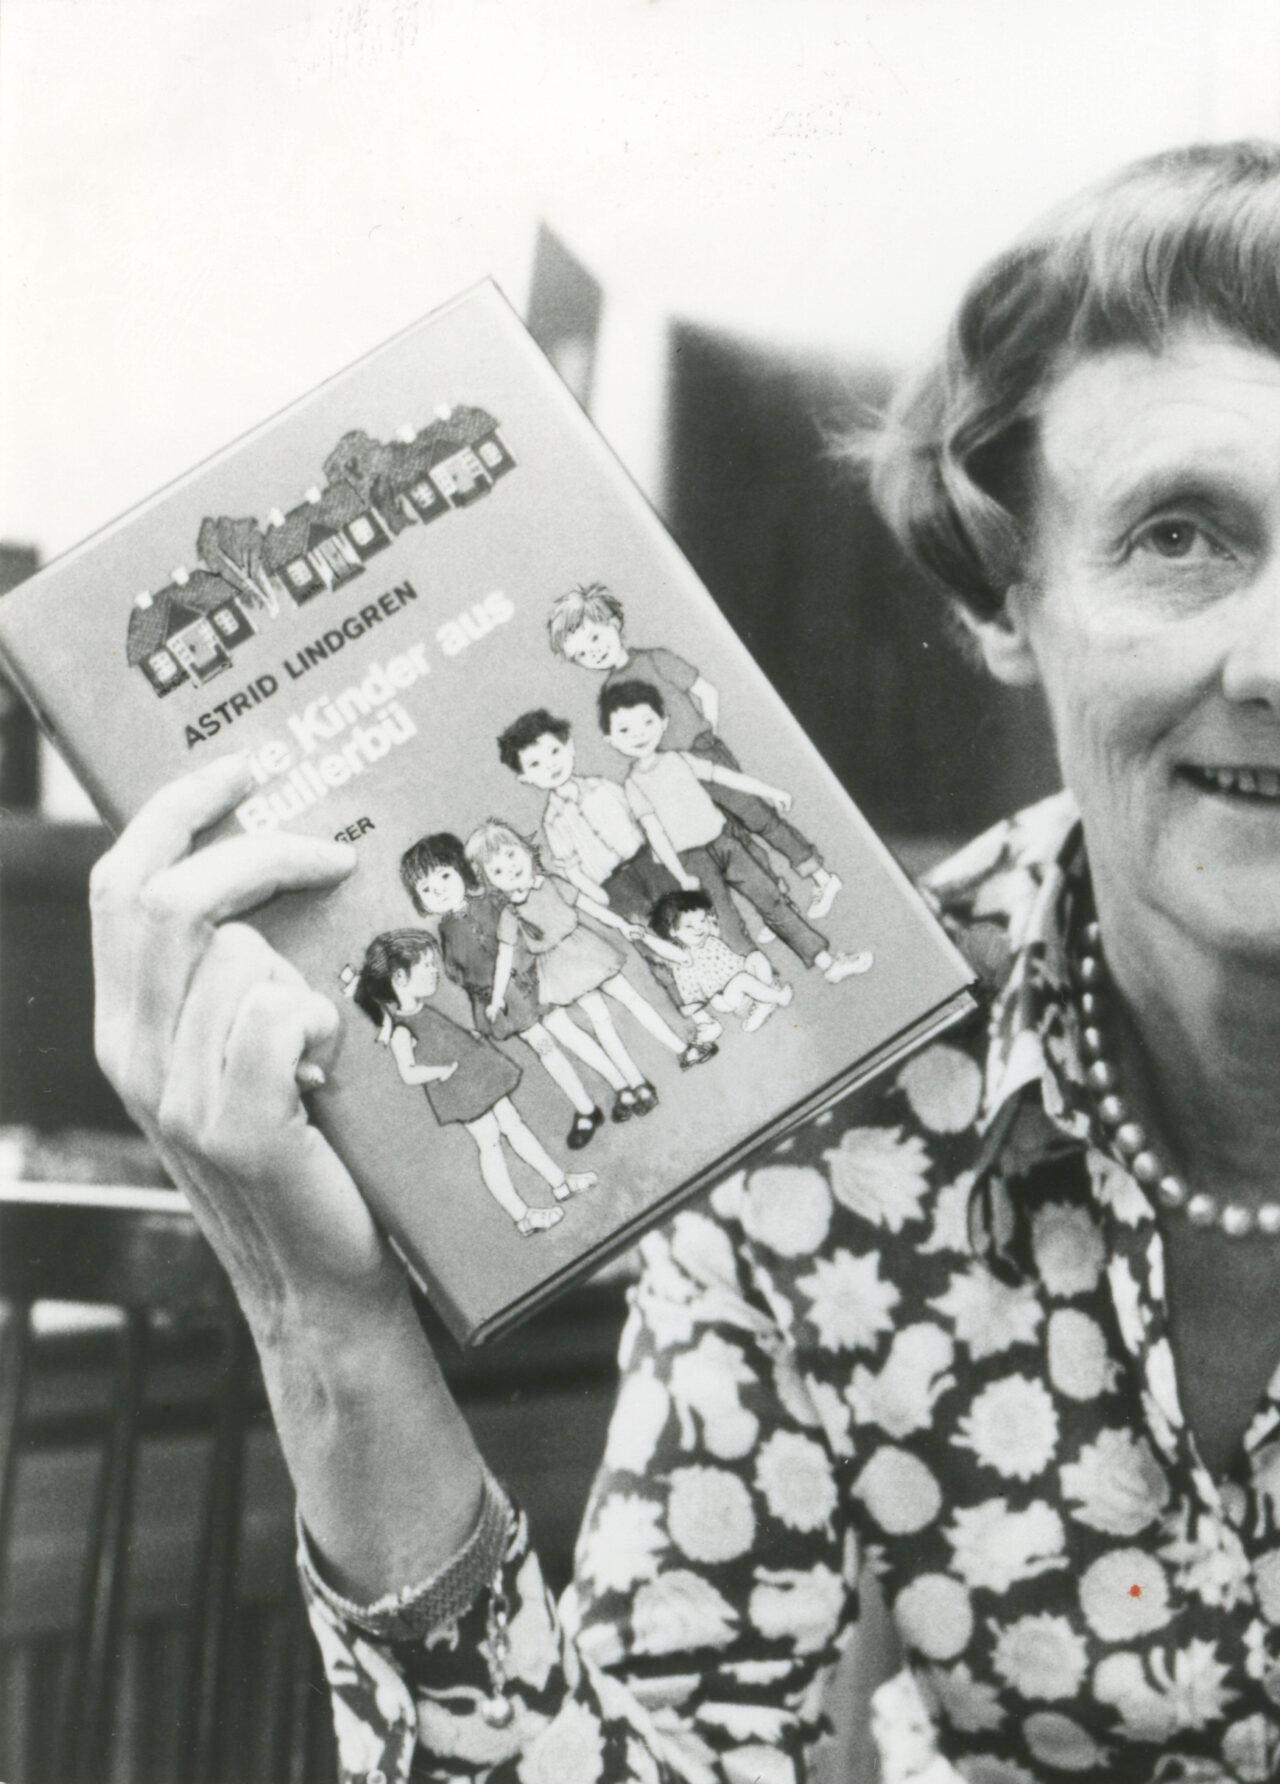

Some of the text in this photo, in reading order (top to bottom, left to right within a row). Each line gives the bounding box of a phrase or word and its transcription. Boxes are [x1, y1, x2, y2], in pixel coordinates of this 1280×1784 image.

[183, 580, 419, 750] ASTRID LINDGREN
[287, 643, 431, 751] Kinder
[435, 589, 515, 657] aus
[236, 704, 417, 836] Bullerbü
